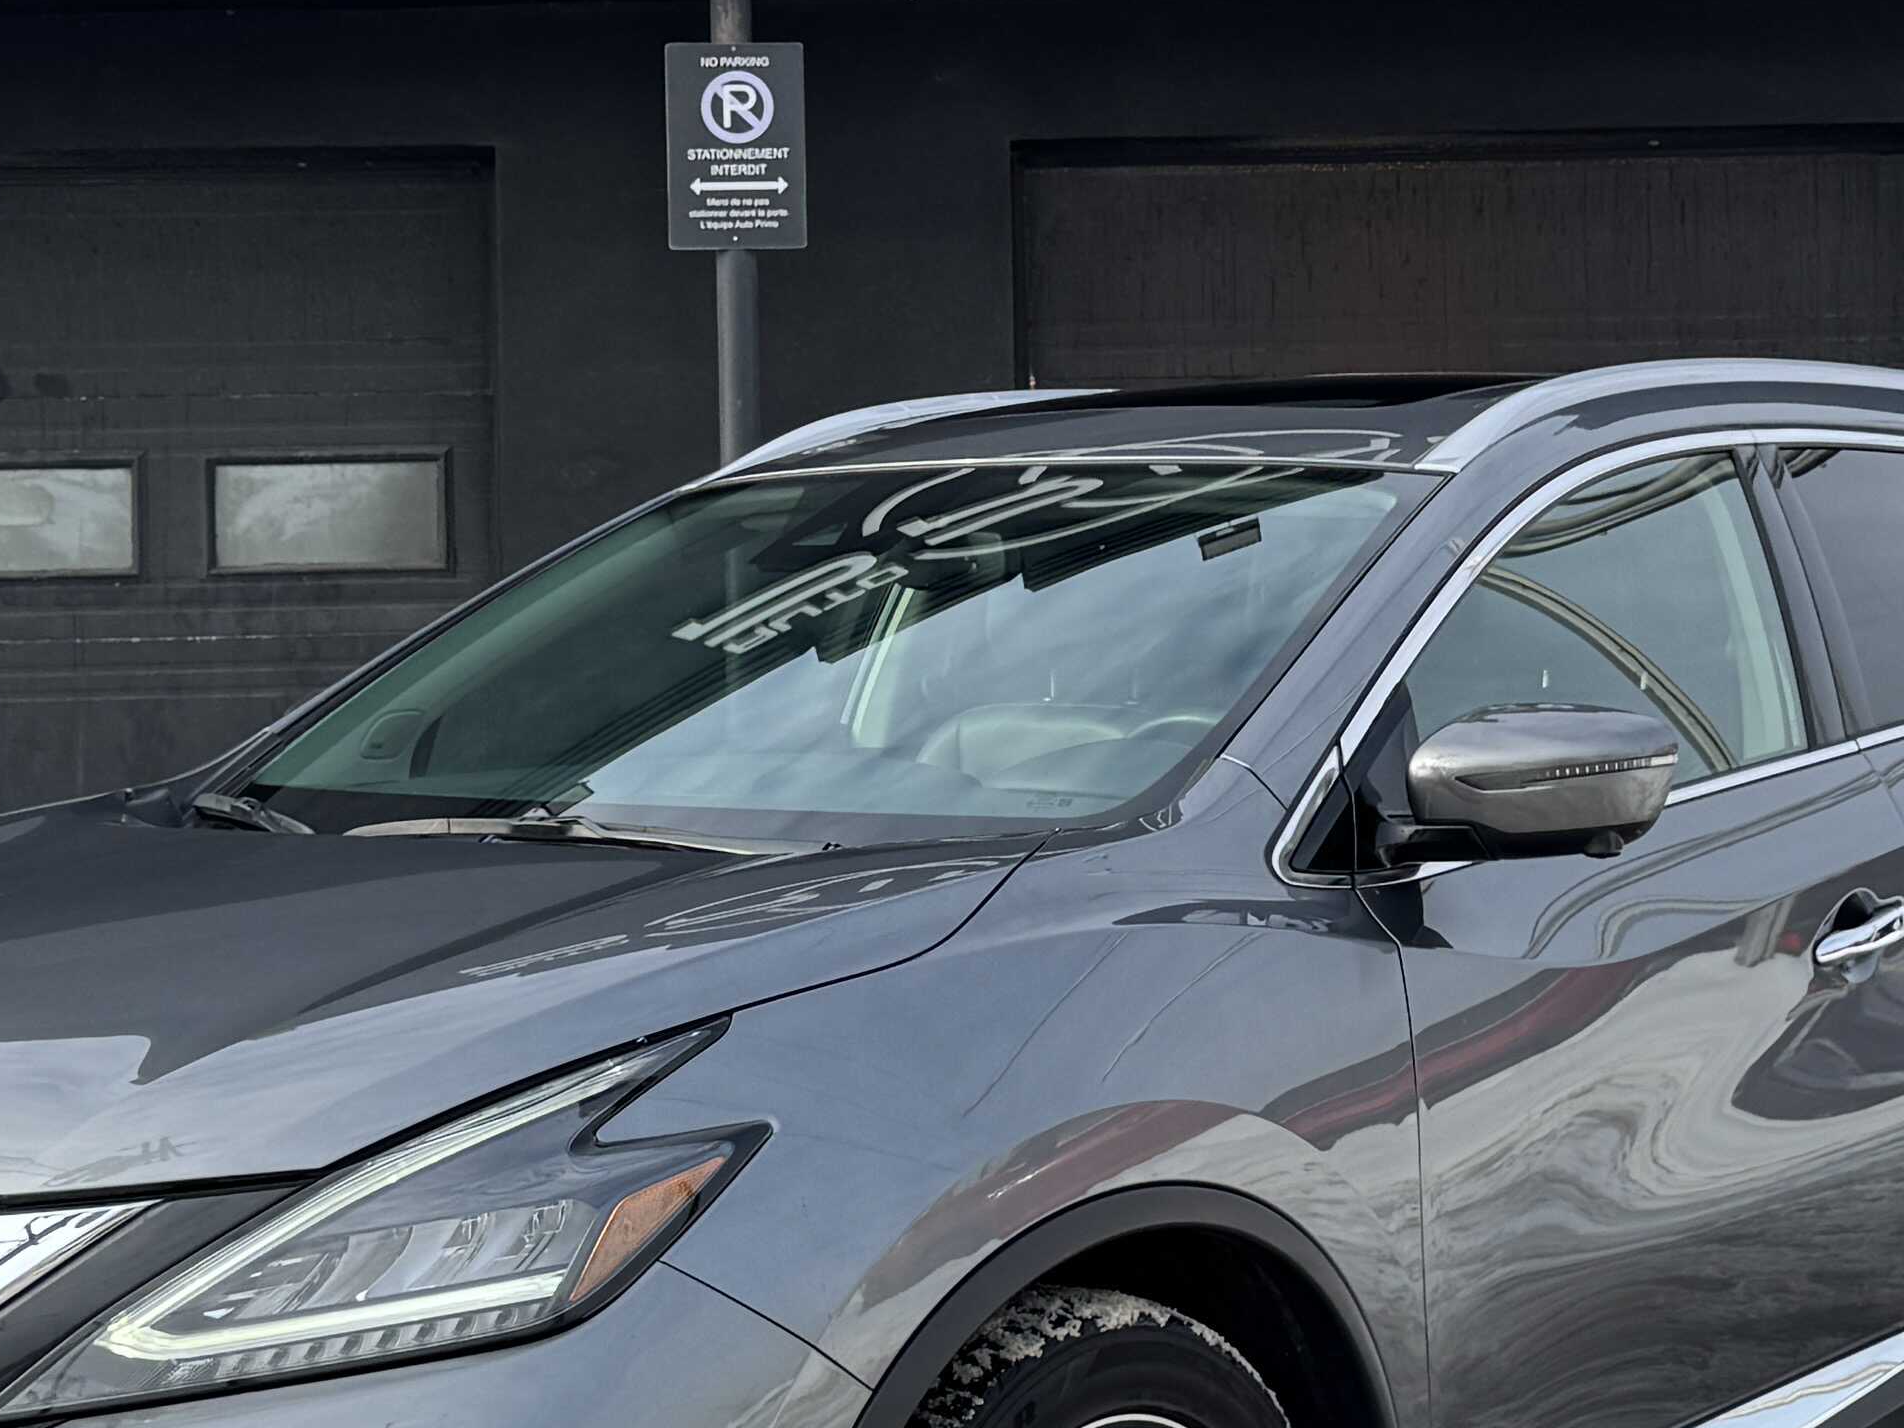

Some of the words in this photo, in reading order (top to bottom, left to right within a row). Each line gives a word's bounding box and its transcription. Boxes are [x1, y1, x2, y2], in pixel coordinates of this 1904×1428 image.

[700, 56, 719, 68] NO
[720, 56, 770, 67] PARKING
[687, 147, 790, 161] STATIONNEMENT
[710, 163, 768, 176] INTERDIT
